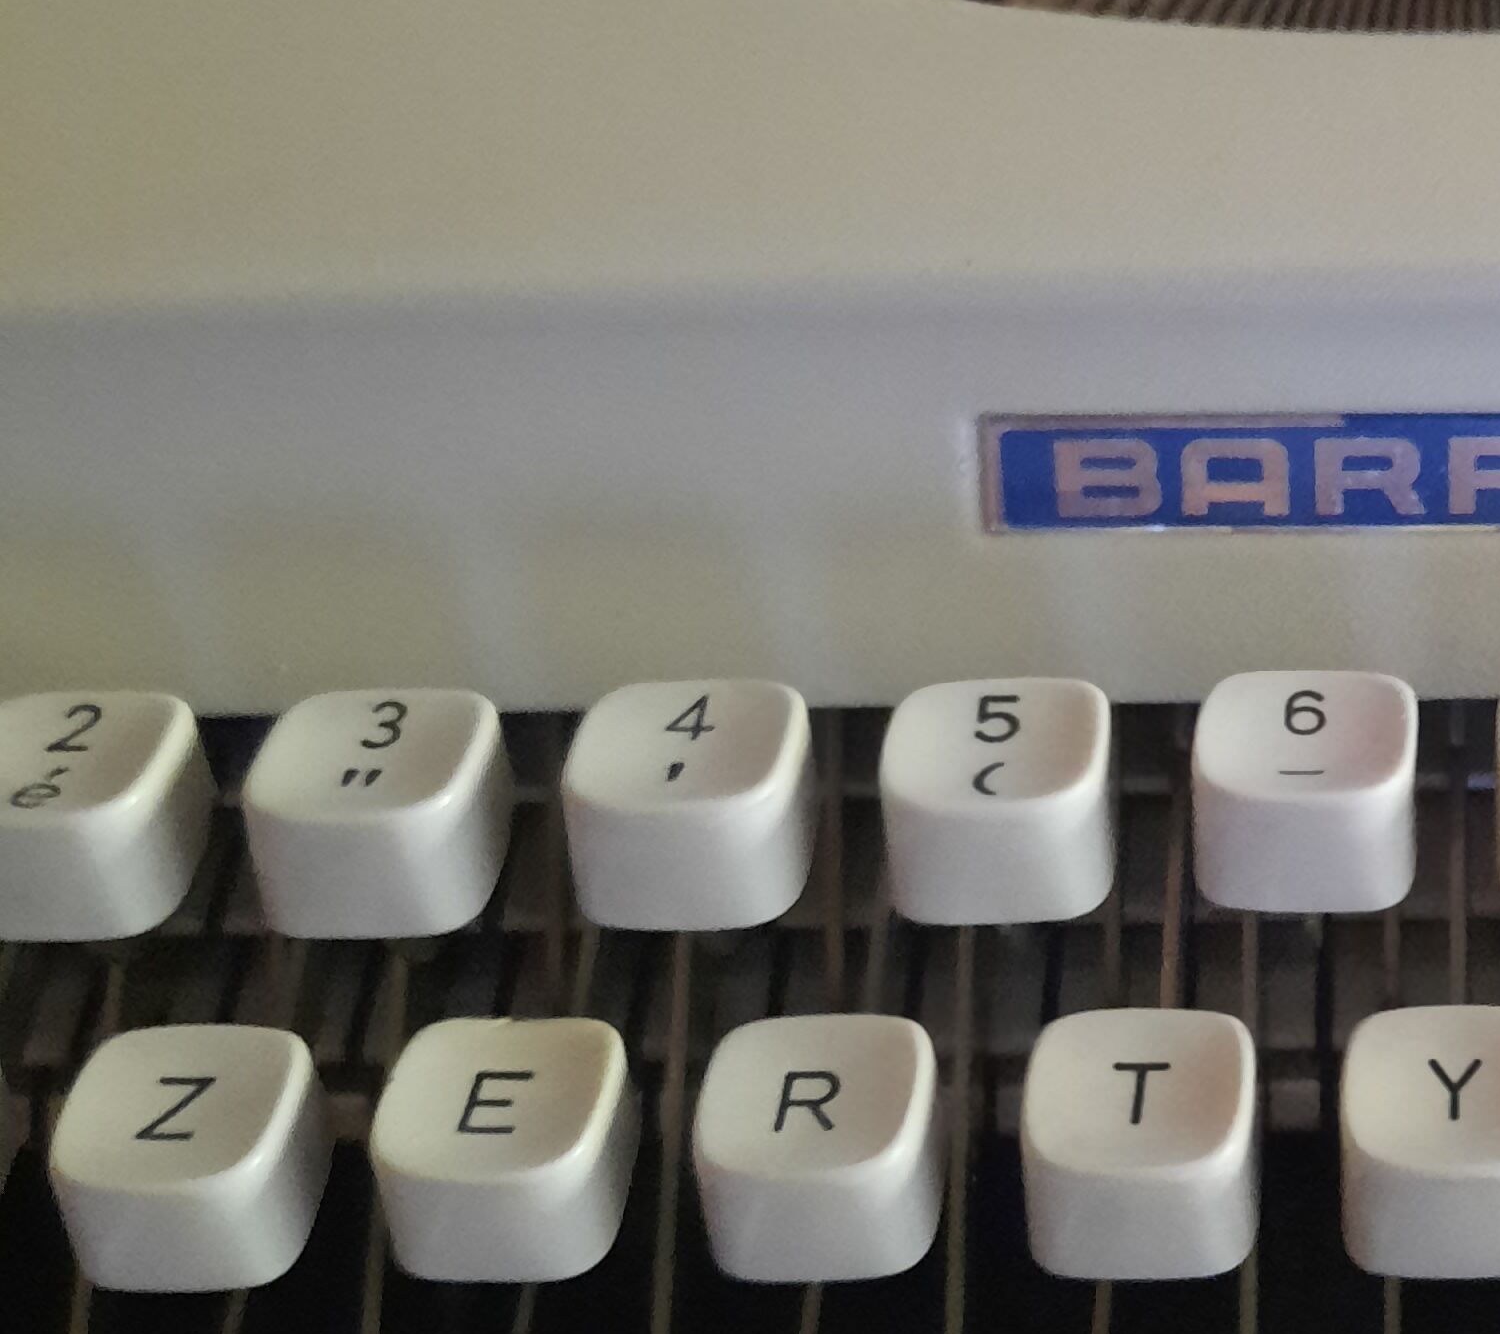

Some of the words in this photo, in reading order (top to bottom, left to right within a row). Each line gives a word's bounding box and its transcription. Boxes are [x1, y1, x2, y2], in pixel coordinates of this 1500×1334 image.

[46, 704, 101, 752] 2
[360, 701, 408, 749] 3
[665, 694, 715, 741] 4
[973, 695, 1021, 743] 5
[1283, 690, 1327, 735] 6
[10, 767, 69, 809] é
[135, 1076, 216, 1141] Z
[456, 1070, 535, 1134] E
[773, 1070, 842, 1133] R
[1112, 1062, 1171, 1124] T
[1428, 1058, 1483, 1121] Y
